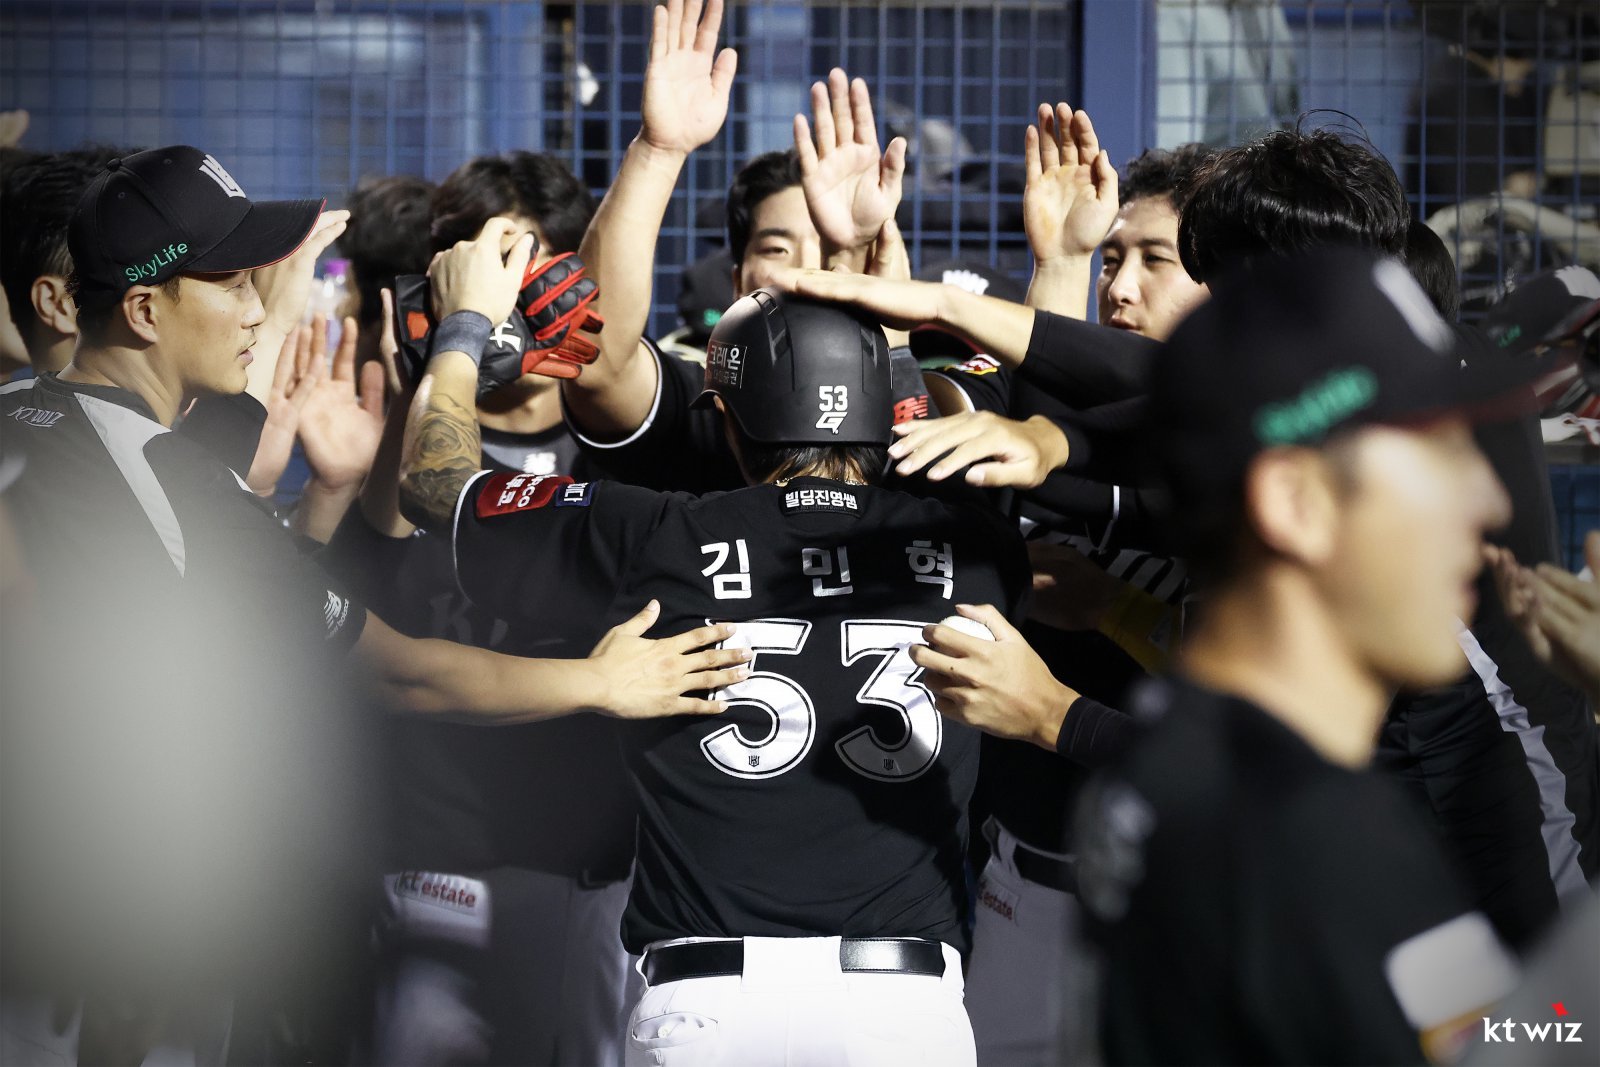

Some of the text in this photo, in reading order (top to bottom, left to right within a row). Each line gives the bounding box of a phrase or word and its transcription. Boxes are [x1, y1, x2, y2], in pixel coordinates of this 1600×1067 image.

[125, 242, 189, 283] SkyLife
[818, 385, 848, 412] 53
[785, 489, 859, 510] 빌딩진영쌤
[700, 617, 943, 784] 53
[422, 880, 476, 908] estate
